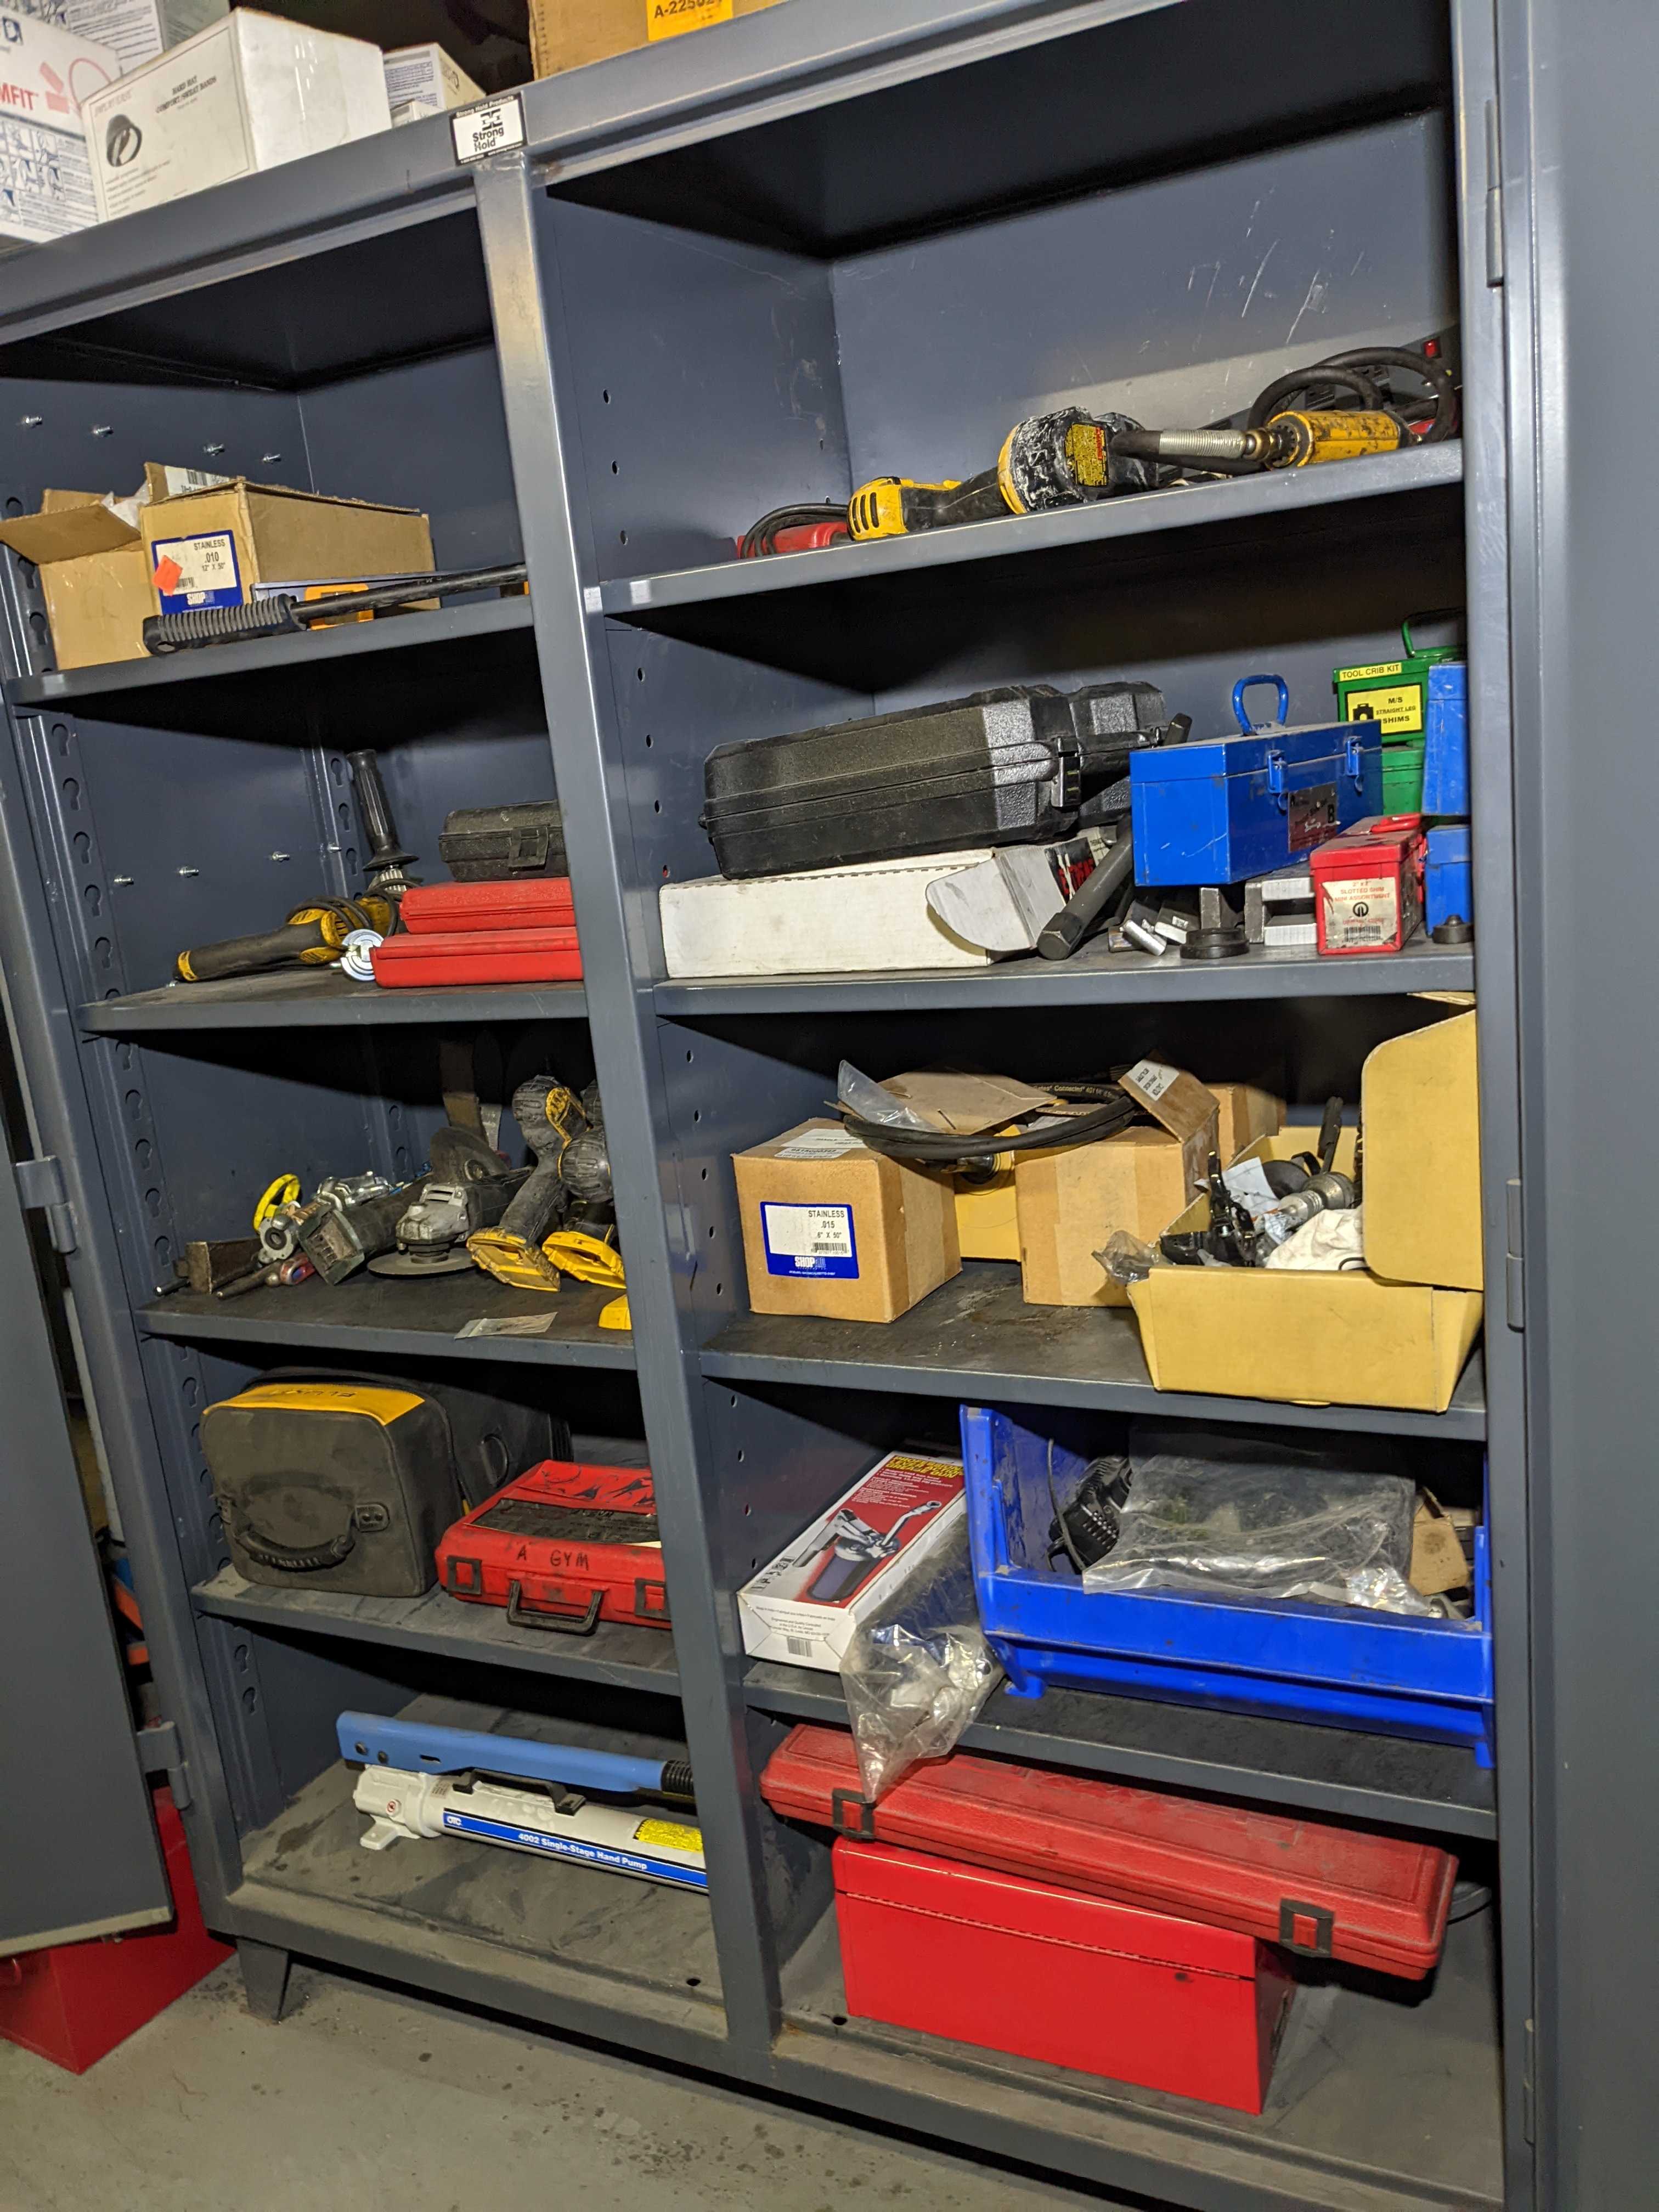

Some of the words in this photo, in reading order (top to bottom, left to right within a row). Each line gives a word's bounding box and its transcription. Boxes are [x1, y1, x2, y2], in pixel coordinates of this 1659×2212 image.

[456, 108, 475, 118] Strong
[475, 103, 489, 112] Hold
[489, 95, 514, 108] Products
[472, 127, 504, 143] Strong
[473, 138, 496, 152] Hold
[194, 539, 225, 551] STAINLESS
[205, 552, 219, 563] .010
[1383, 715, 1410, 724] SHIMS
[930, 1468, 958, 1479] GUN
[516, 1544, 527, 1561] A
[550, 1549, 589, 1571] GYM
[447, 1816, 462, 1826] OTC
[518, 1833, 540, 1844] 4002
[541, 1838, 595, 1858] Single-Stage
[596, 1850, 620, 1864] Hand
[622, 1857, 648, 1871] Pump
